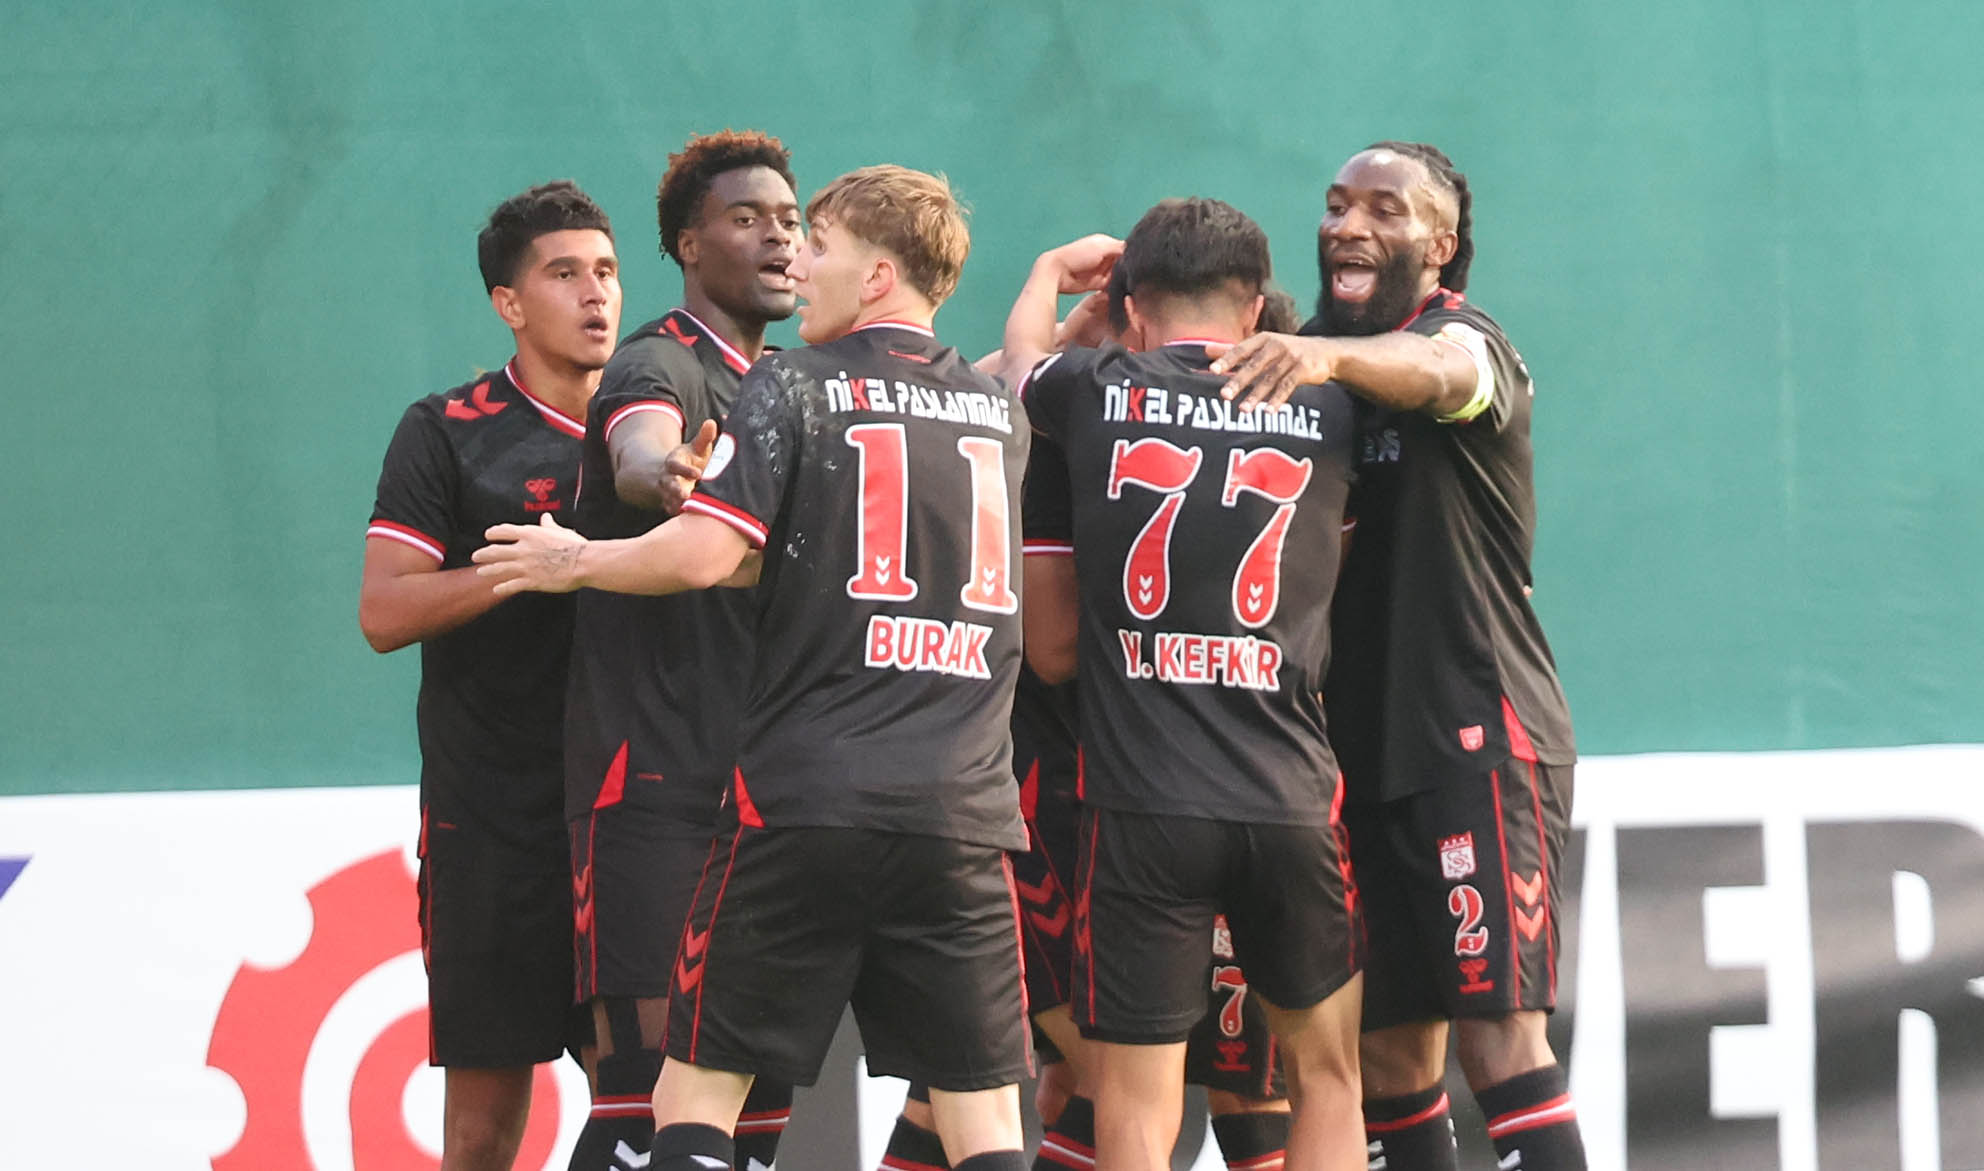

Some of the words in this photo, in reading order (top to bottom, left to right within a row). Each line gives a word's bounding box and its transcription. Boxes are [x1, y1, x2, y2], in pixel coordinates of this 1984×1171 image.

[845, 423, 1018, 615] 11
[1107, 437, 1313, 629] 77
[864, 614, 994, 680] BURAK
[1448, 884, 1489, 956] 2
[1211, 966, 1248, 1037] 7
